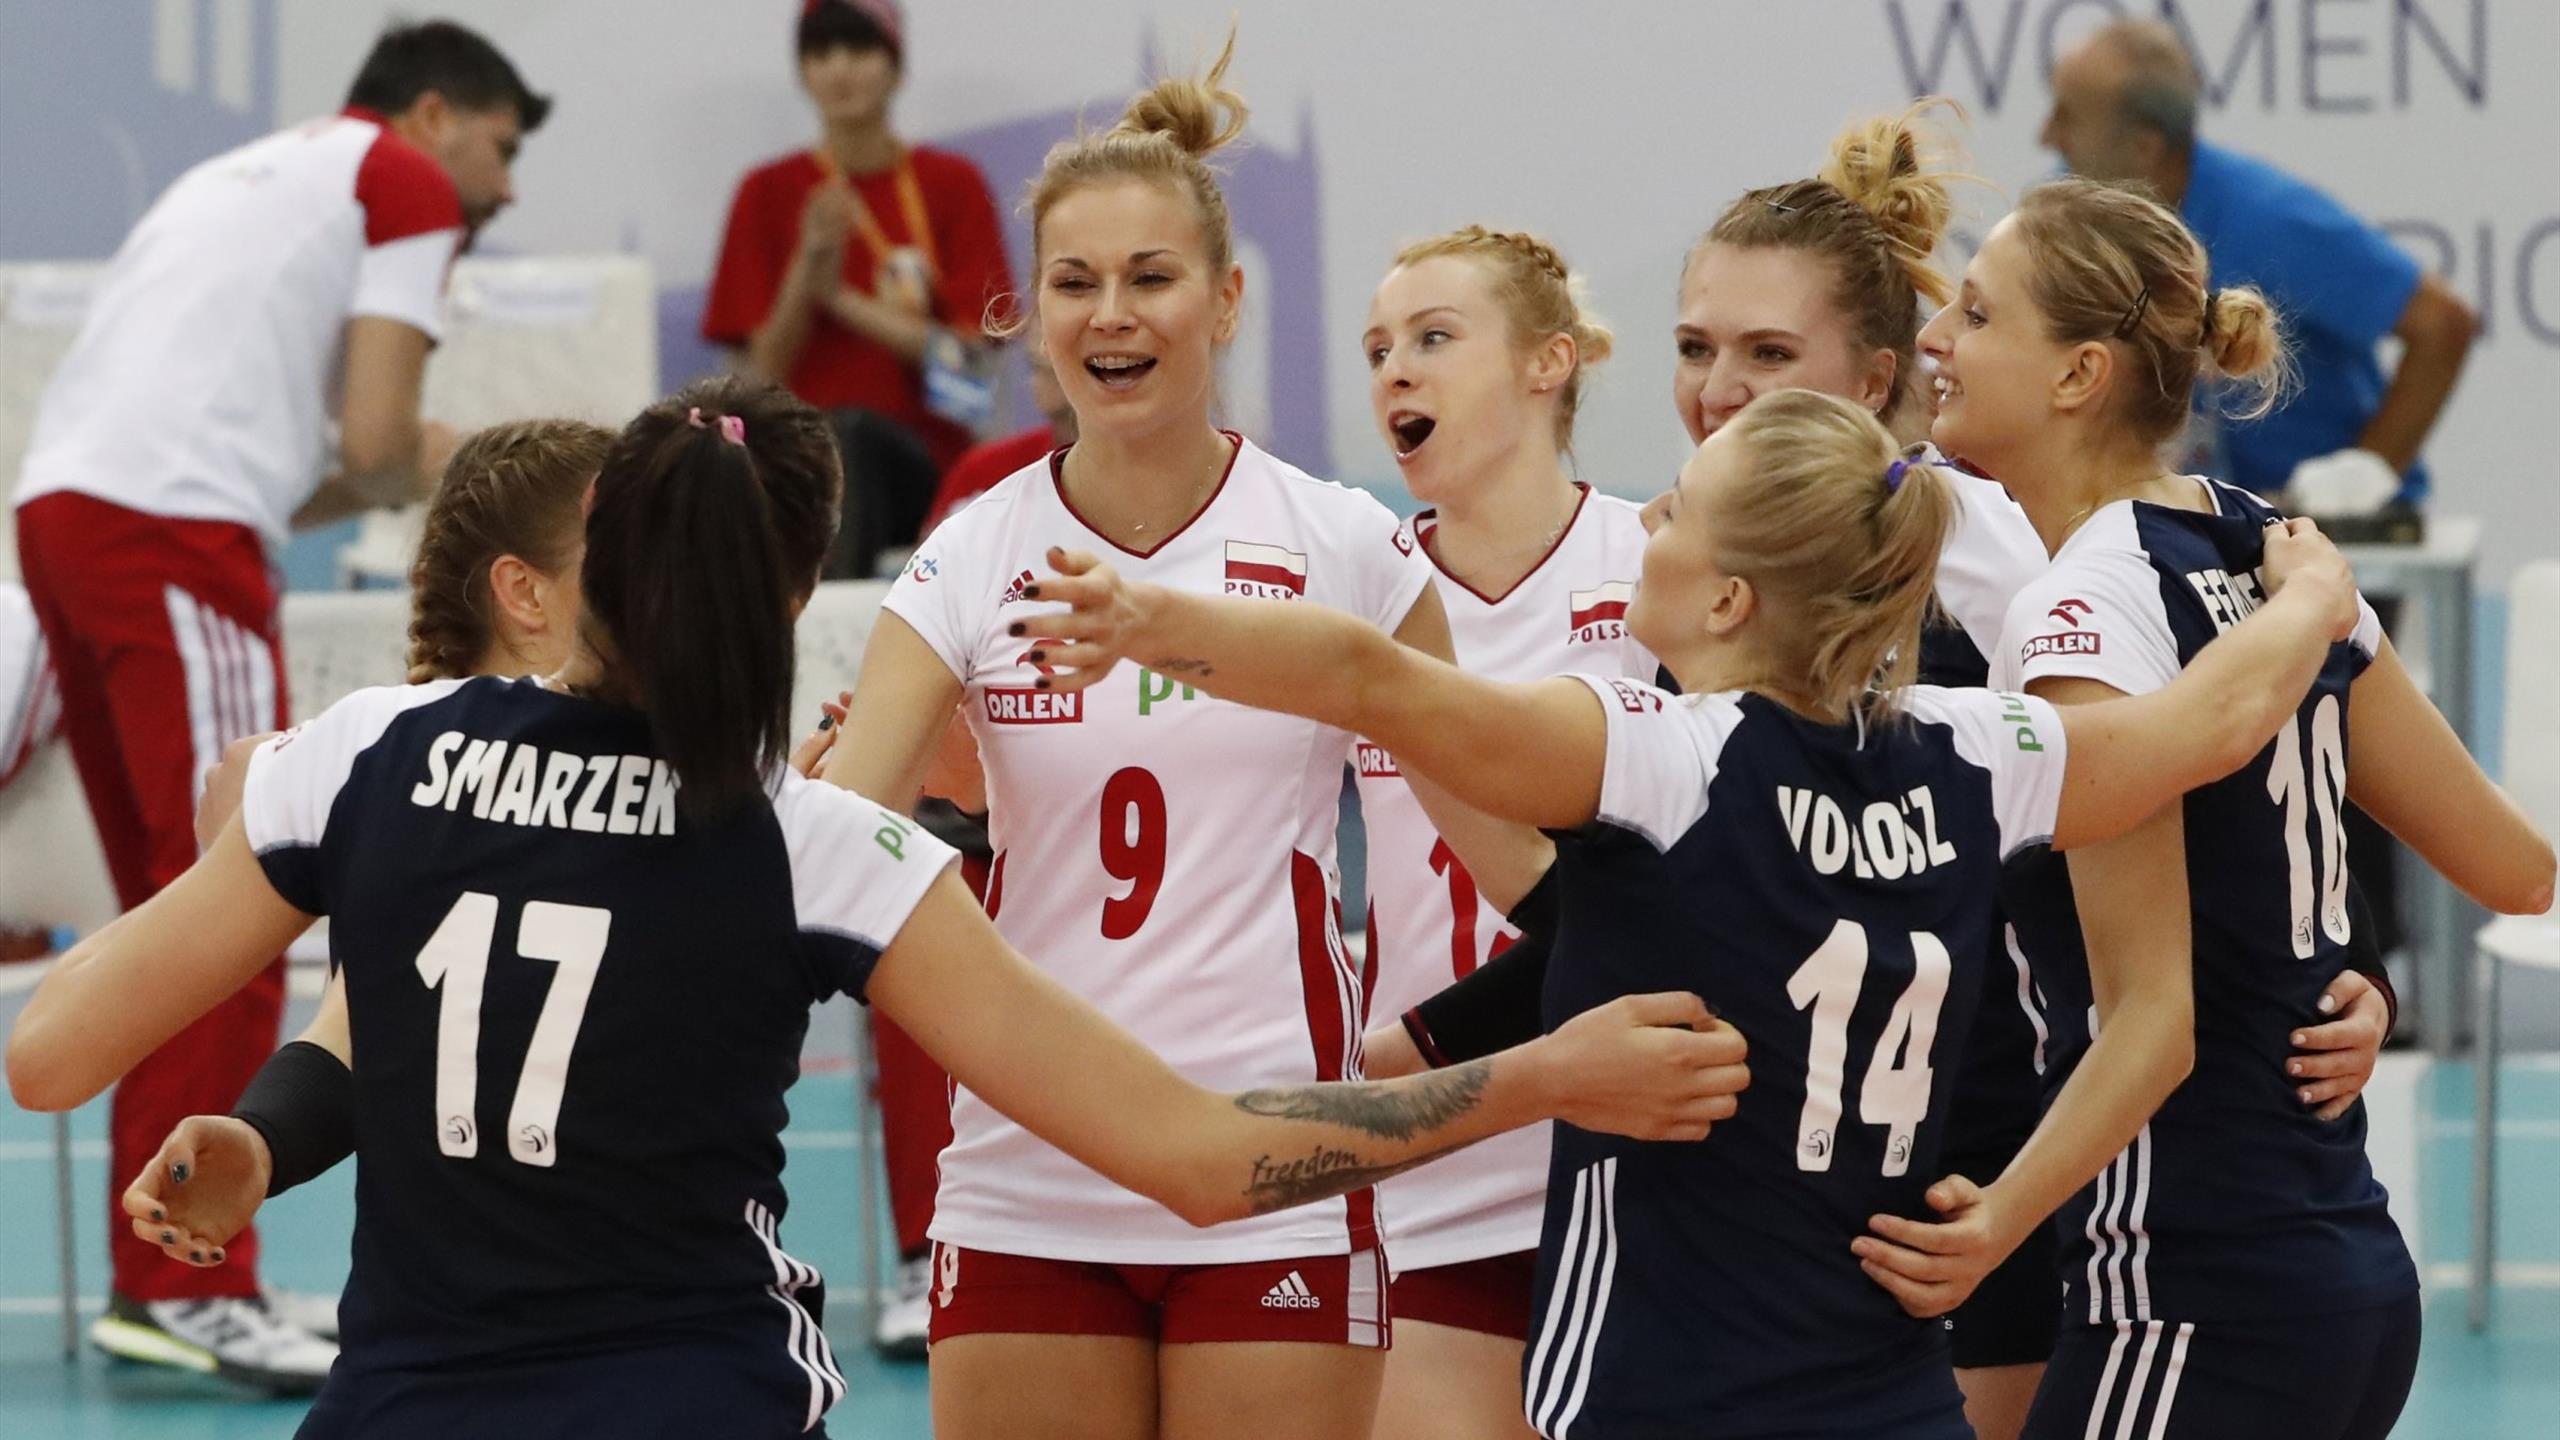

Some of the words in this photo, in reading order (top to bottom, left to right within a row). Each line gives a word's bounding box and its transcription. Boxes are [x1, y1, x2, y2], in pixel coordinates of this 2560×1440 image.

[1224, 582, 1302, 601] POLSK
[1568, 623, 1629, 645] POLS
[2022, 633, 2096, 661] ORLEN
[987, 692, 1075, 719] ORLEN
[1994, 690, 2044, 752] plu
[1360, 747, 1397, 772] ORL
[2266, 694, 2351, 959] 10
[1099, 766, 1168, 940] 9
[414, 890, 612, 1168] 17
[1786, 918, 1952, 1177] 14
[1248, 1145, 1359, 1190] freedom
[1261, 1293, 1321, 1309] adidas
